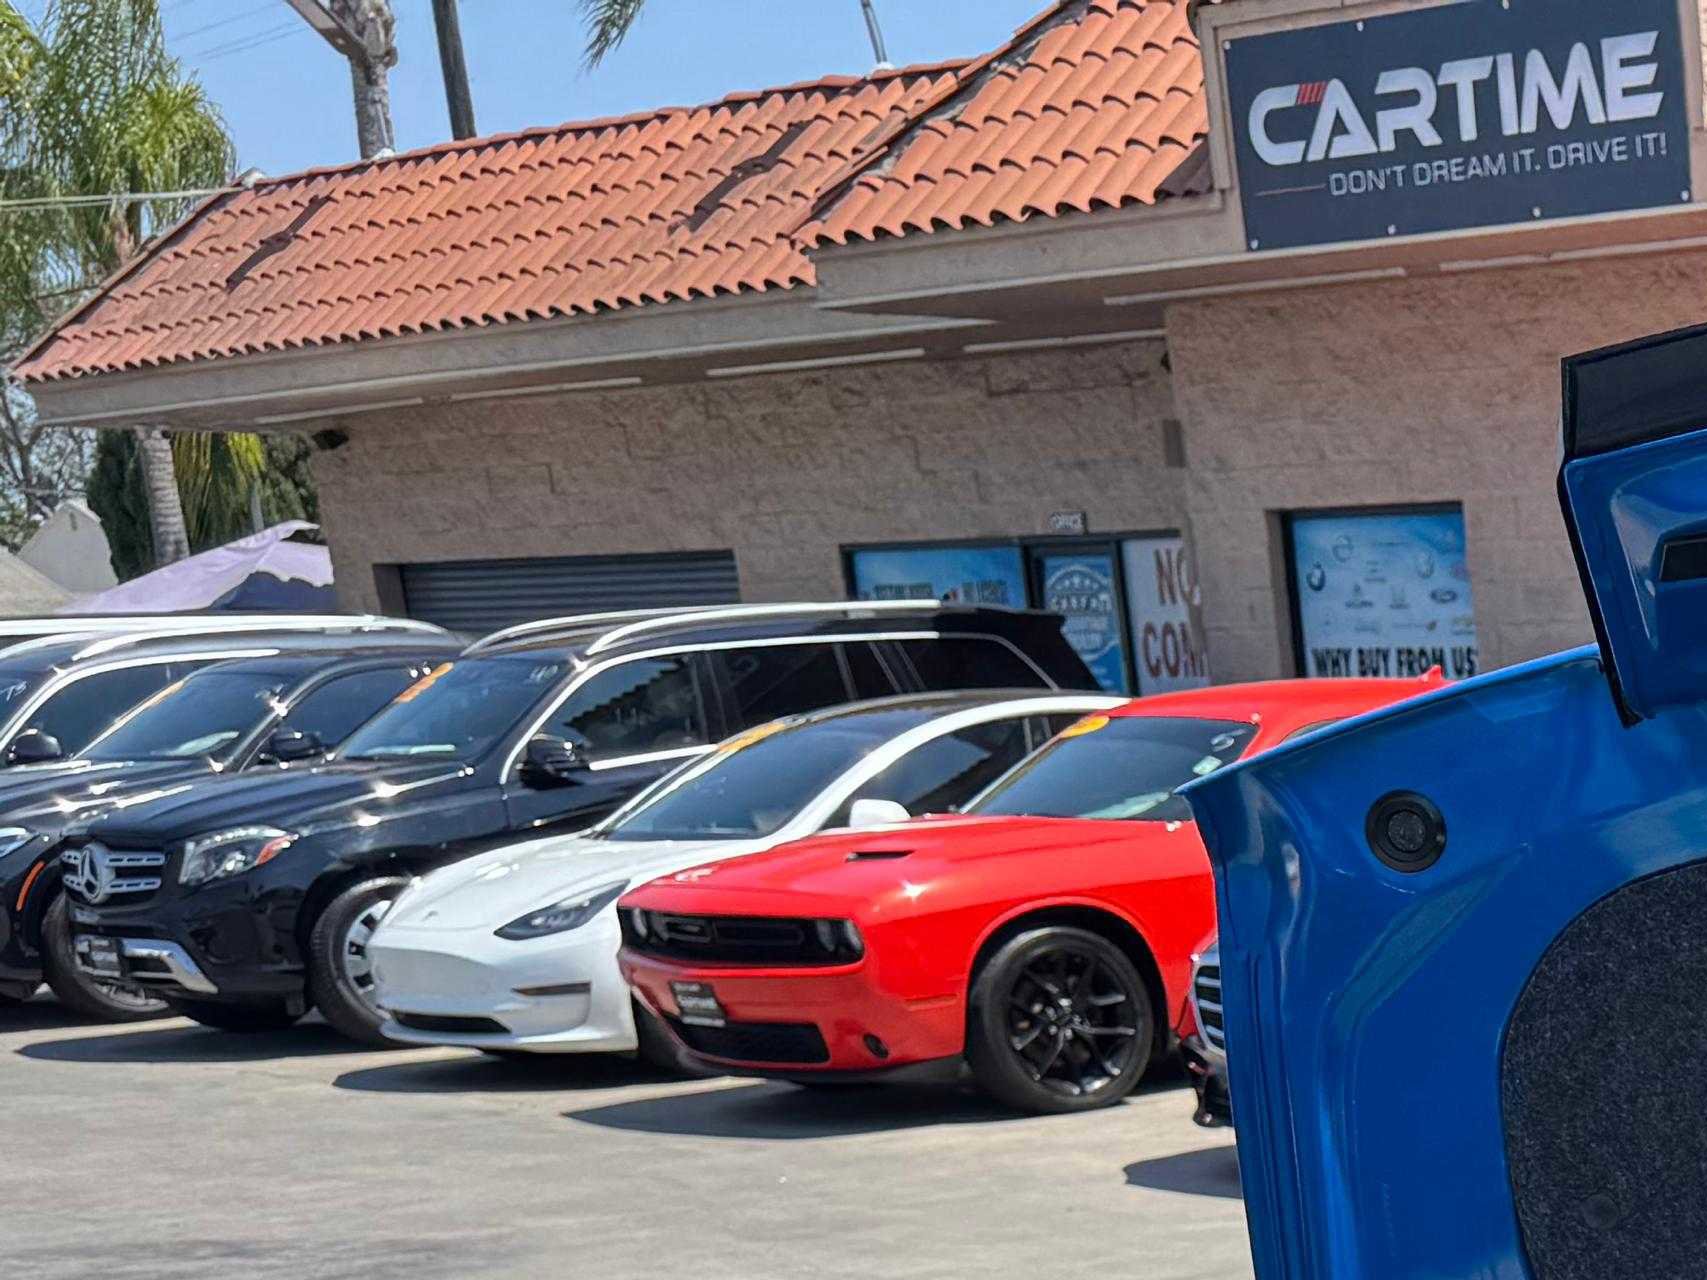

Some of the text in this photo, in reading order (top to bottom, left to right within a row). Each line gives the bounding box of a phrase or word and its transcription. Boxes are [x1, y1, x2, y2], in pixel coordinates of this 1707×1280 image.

[1247, 30, 1665, 166] CARTIME
[1328, 131, 1668, 197] DON'T DREAM IT. DRIVE IT!
[1310, 645, 1480, 678] WHY BUY FROM US
